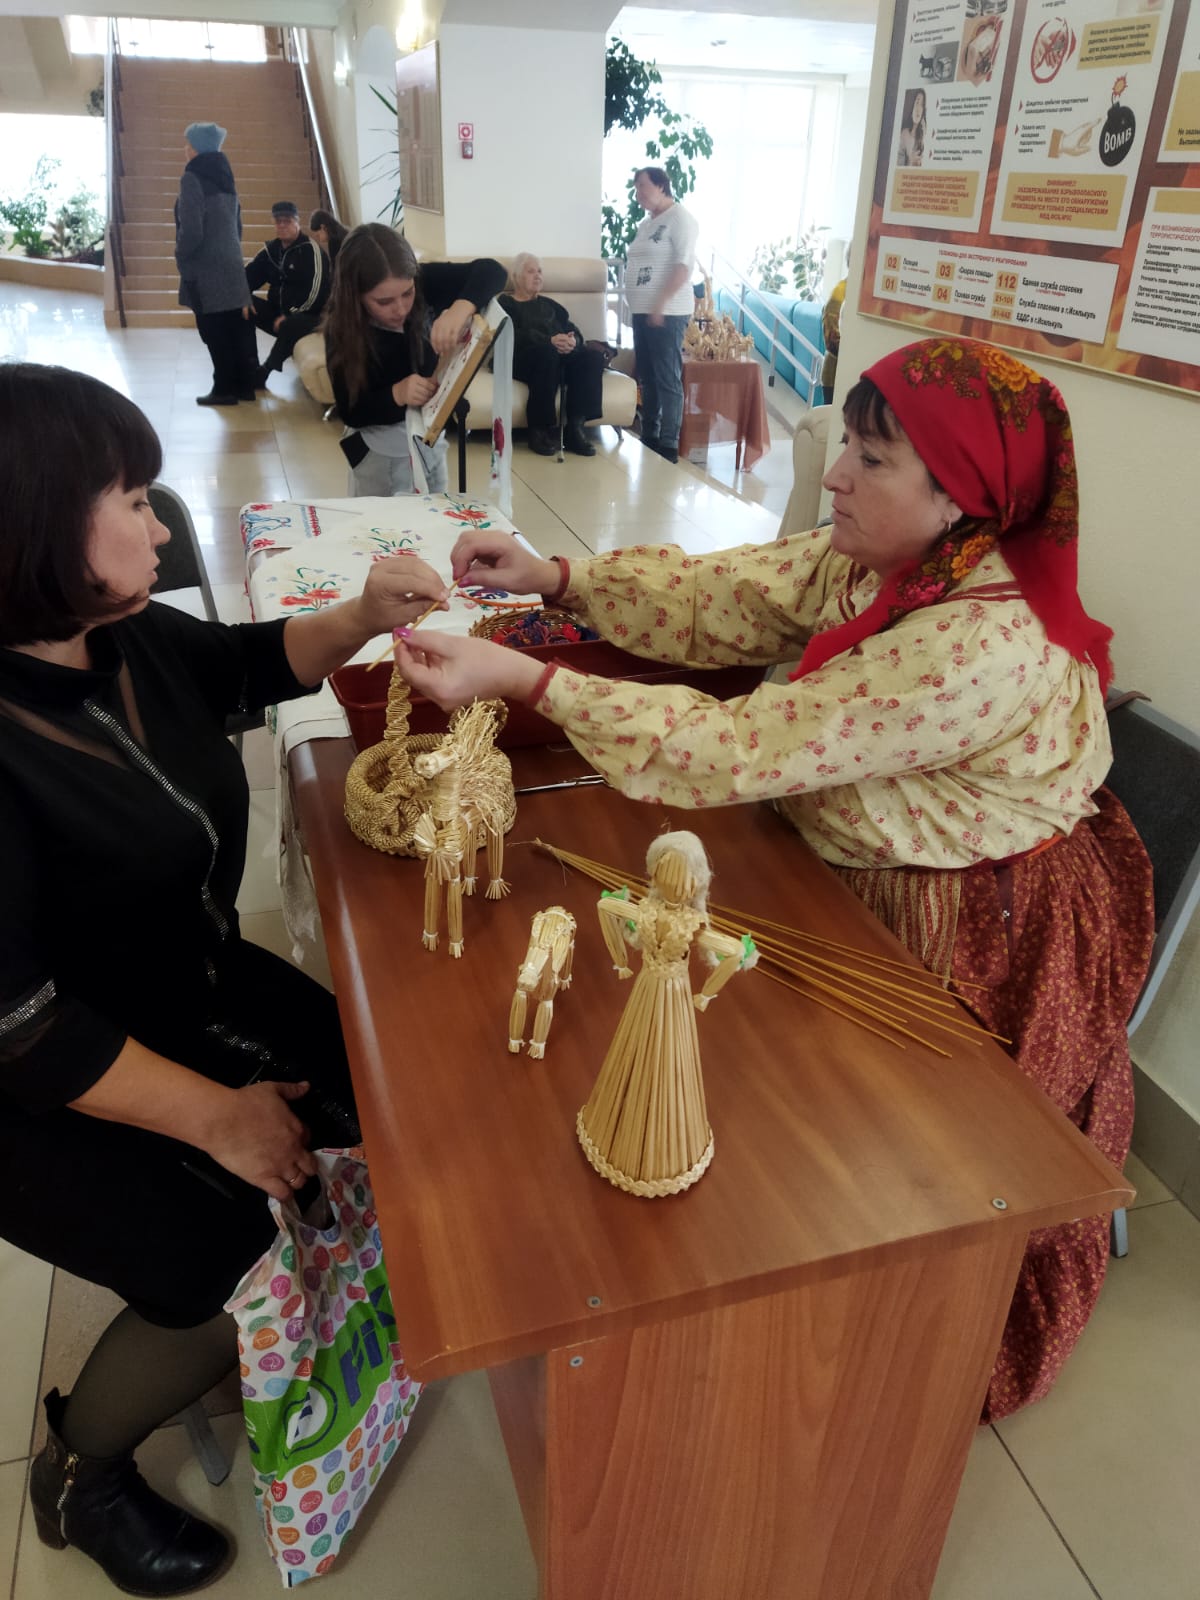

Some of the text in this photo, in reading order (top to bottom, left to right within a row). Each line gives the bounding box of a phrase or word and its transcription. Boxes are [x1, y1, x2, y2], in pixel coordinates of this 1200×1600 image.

[1104, 128, 1131, 153] BOMB
[887, 256, 898, 269] 02
[940, 264, 951, 277] 03
[885, 278, 895, 290] 01
[998, 273, 1016, 289] 112
[1022, 277, 1039, 287] Единая
[1040, 281, 1058, 291] служба
[1059, 284, 1083, 294] спасения
[937, 287, 948, 300] 04
[970, 292, 986, 303] служба
[1019, 298, 1036, 309] Служба
[1037, 301, 1060, 312] спасения
